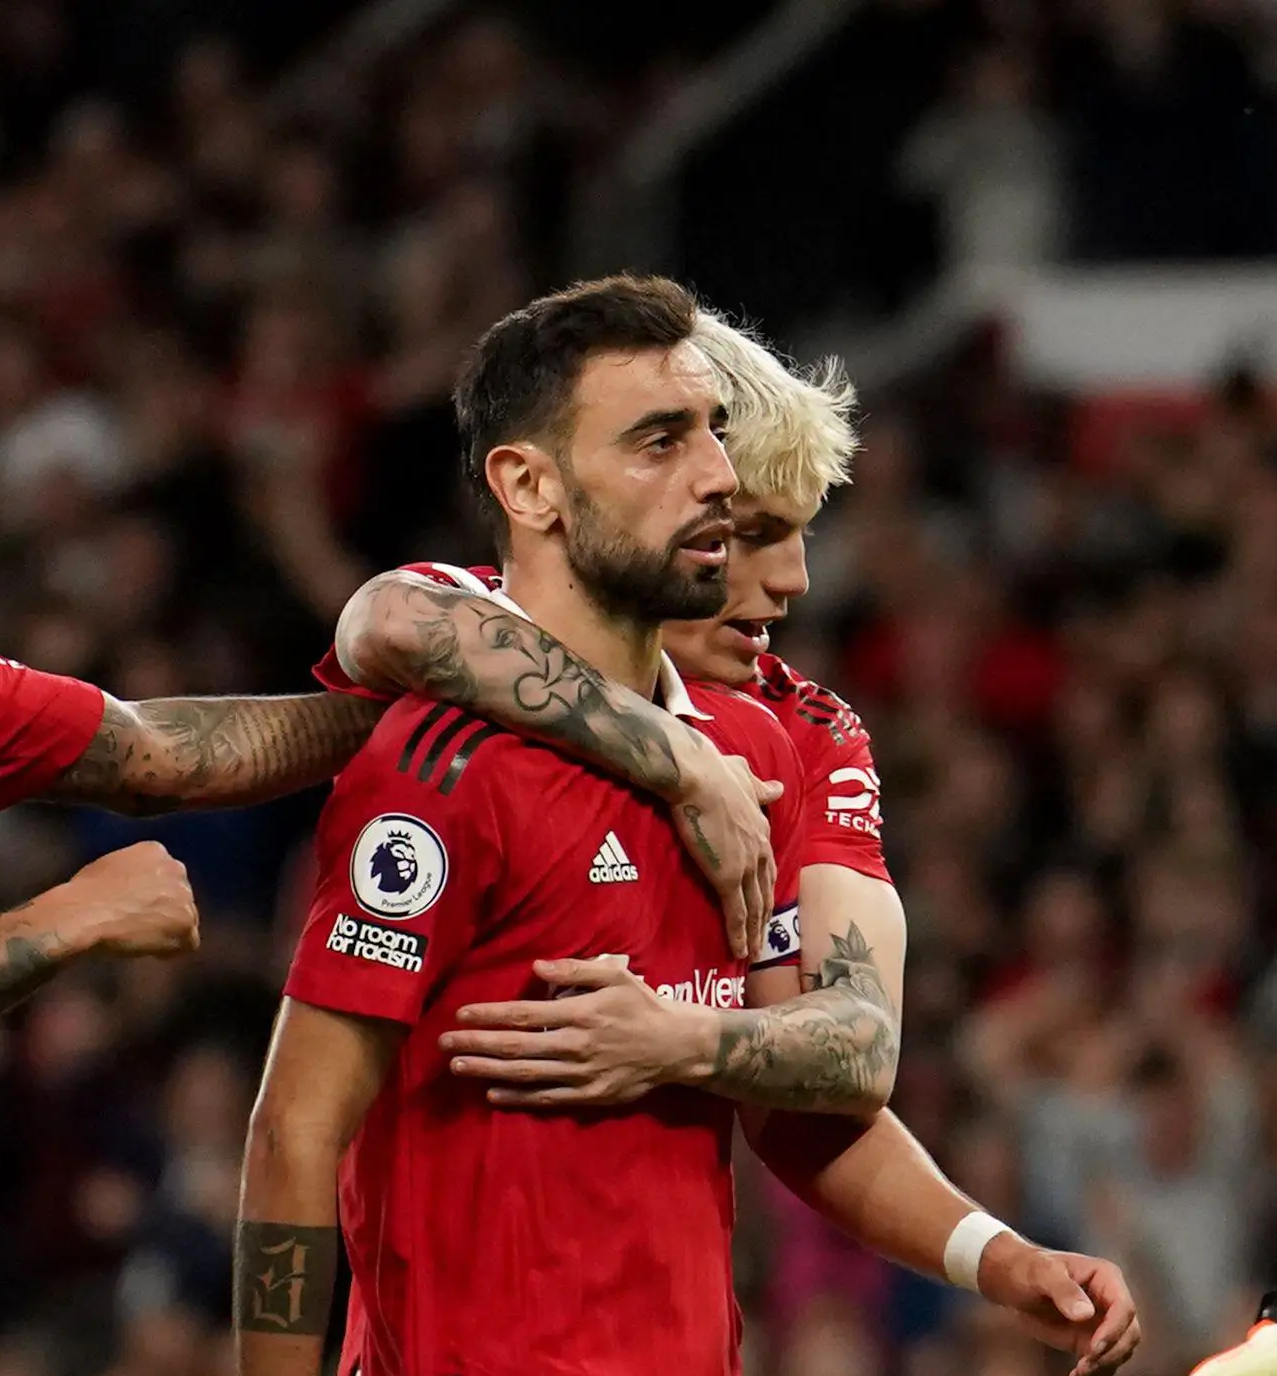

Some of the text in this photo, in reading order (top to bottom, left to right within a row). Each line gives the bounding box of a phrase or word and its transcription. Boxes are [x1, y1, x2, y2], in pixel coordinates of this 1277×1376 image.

[589, 864, 639, 883] adidas
[326, 933, 423, 973] for racism
[332, 913, 419, 954] No room
